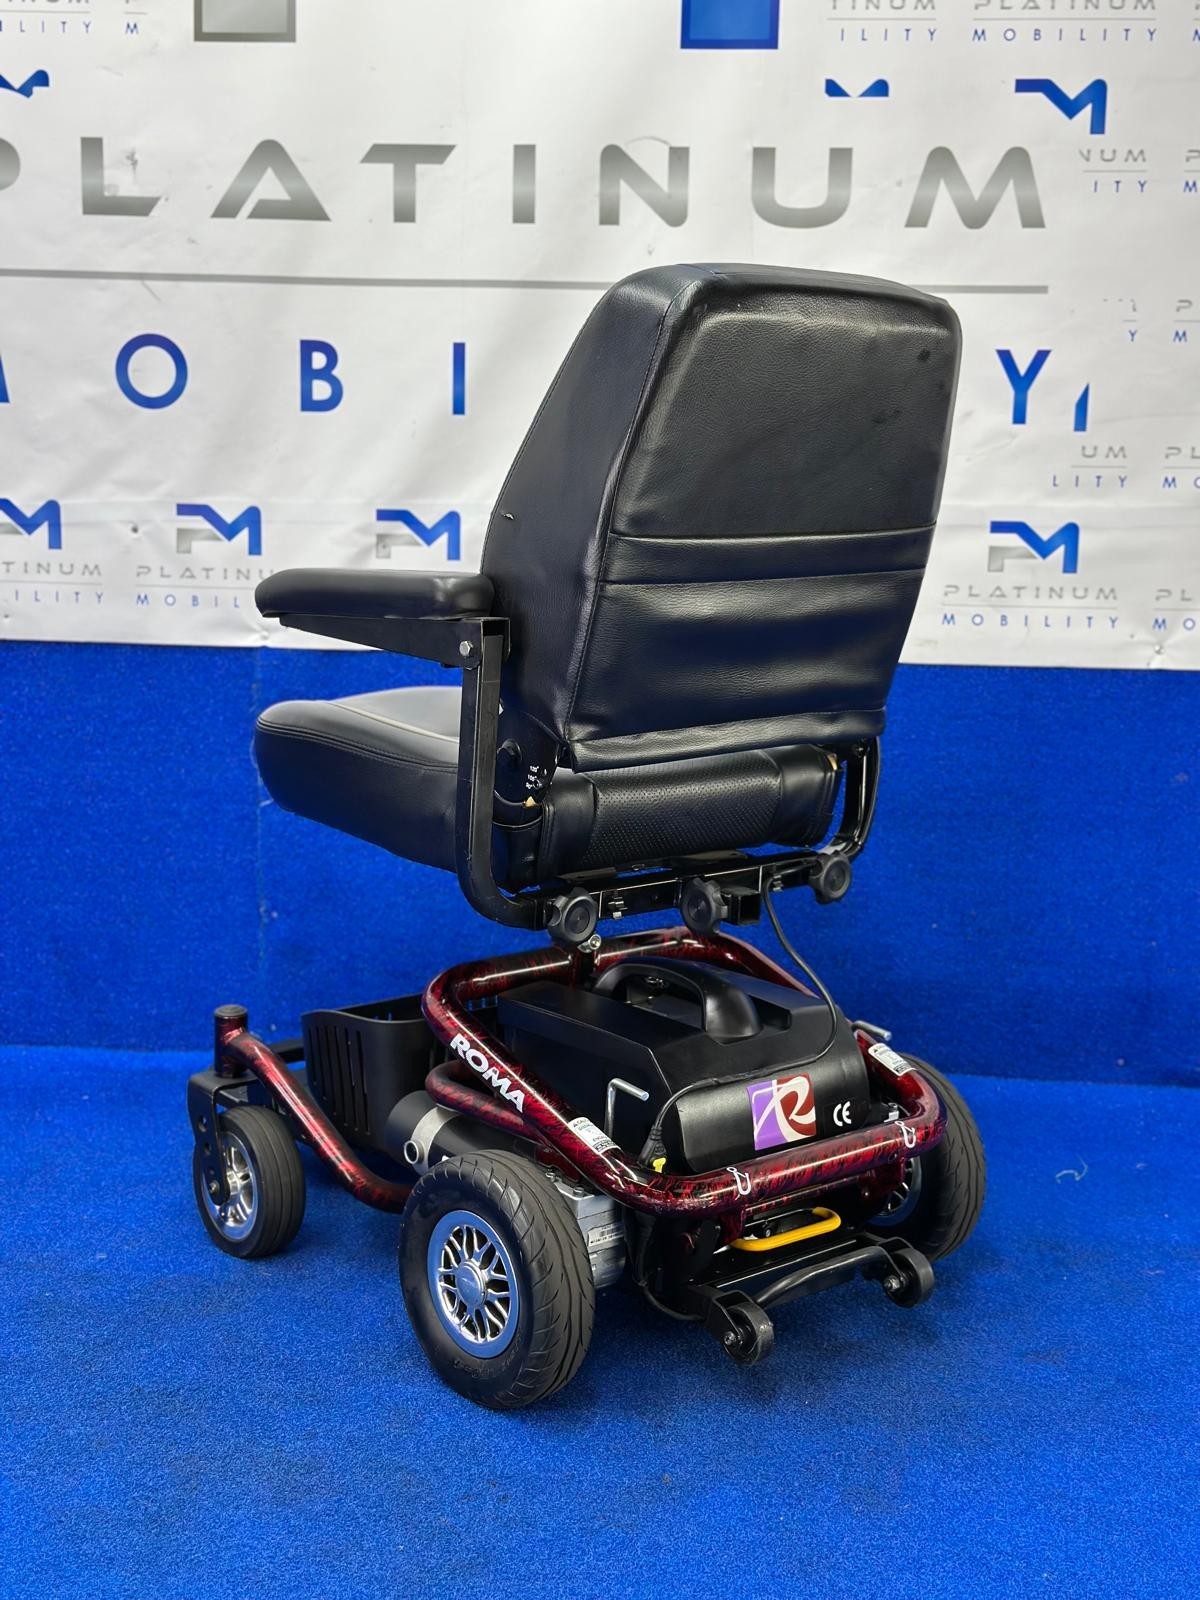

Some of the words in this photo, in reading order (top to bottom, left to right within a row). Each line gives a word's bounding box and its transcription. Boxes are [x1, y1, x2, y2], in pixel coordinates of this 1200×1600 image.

[125, 23, 139, 35] M
[840, 28, 937, 41] ILITY
[972, 28, 1157, 41] MOBILITY
[0, 136, 1046, 230] LATINUM
[1093, 180, 1148, 193] ITY
[1183, 180, 1198, 193] M
[1173, 330, 1188, 342] M
[1081, 445, 1127, 458] UM
[1052, 475, 1128, 488] LITY
[136, 565, 274, 581] PLATINU
[943, 584, 1119, 601] PLATINUM
[1155, 588, 1193, 602] PL
[136, 593, 240, 608] MOBIL
[942, 613, 1119, 629] MOBILITY
[1152, 617, 1197, 632] MO
[450, 1033, 525, 1113] ROMA
